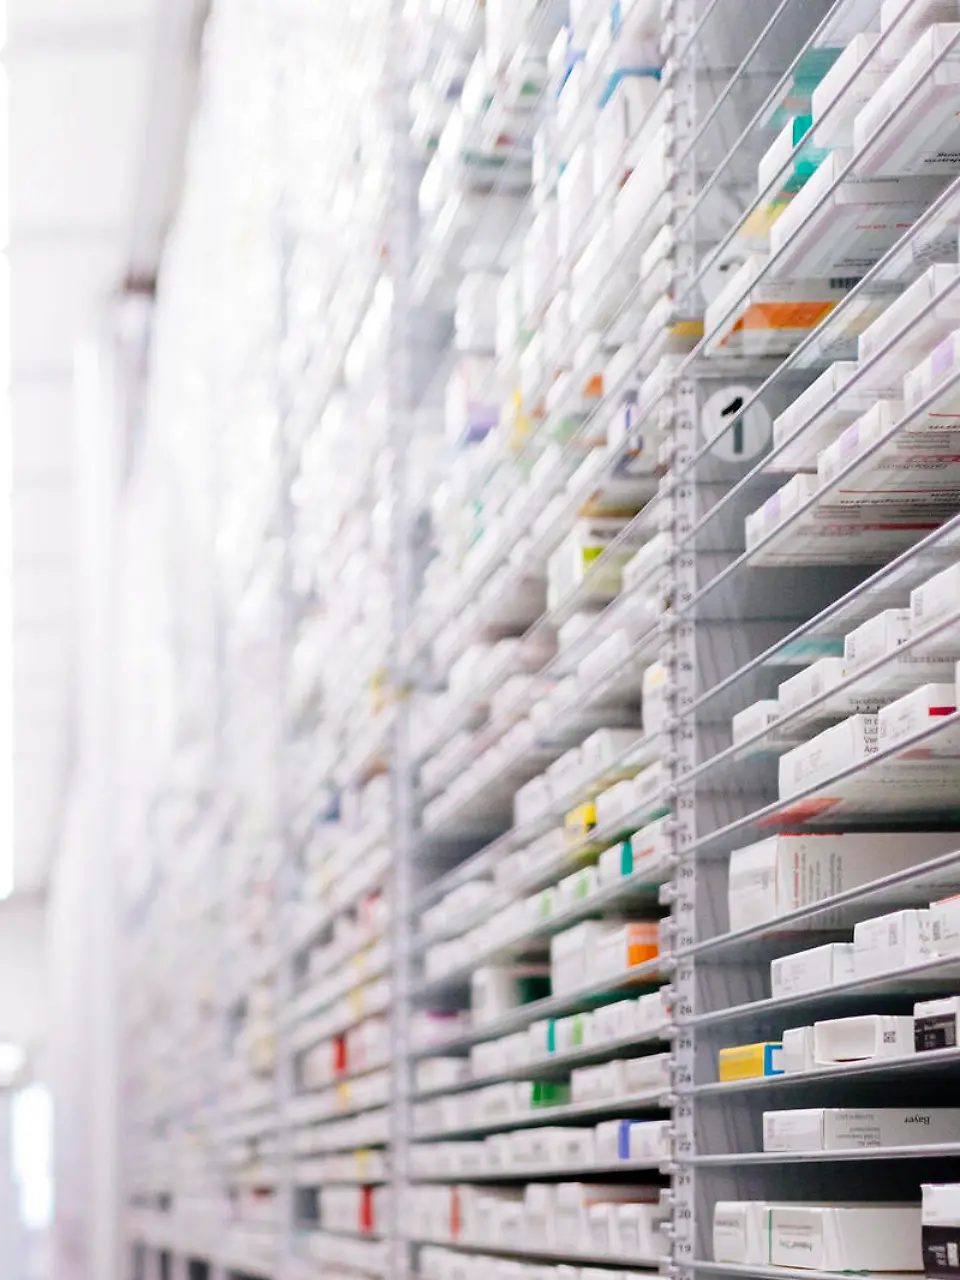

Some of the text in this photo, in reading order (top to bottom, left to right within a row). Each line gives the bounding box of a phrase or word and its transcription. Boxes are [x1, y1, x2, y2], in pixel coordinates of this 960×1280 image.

[721, 396, 743, 454] 1
[679, 971, 692, 980] 27
[904, 1115, 931, 1125] Bayer
[678, 1175, 690, 1185] 21
[678, 1210, 691, 1219] 20
[678, 1244, 691, 1253] 19
